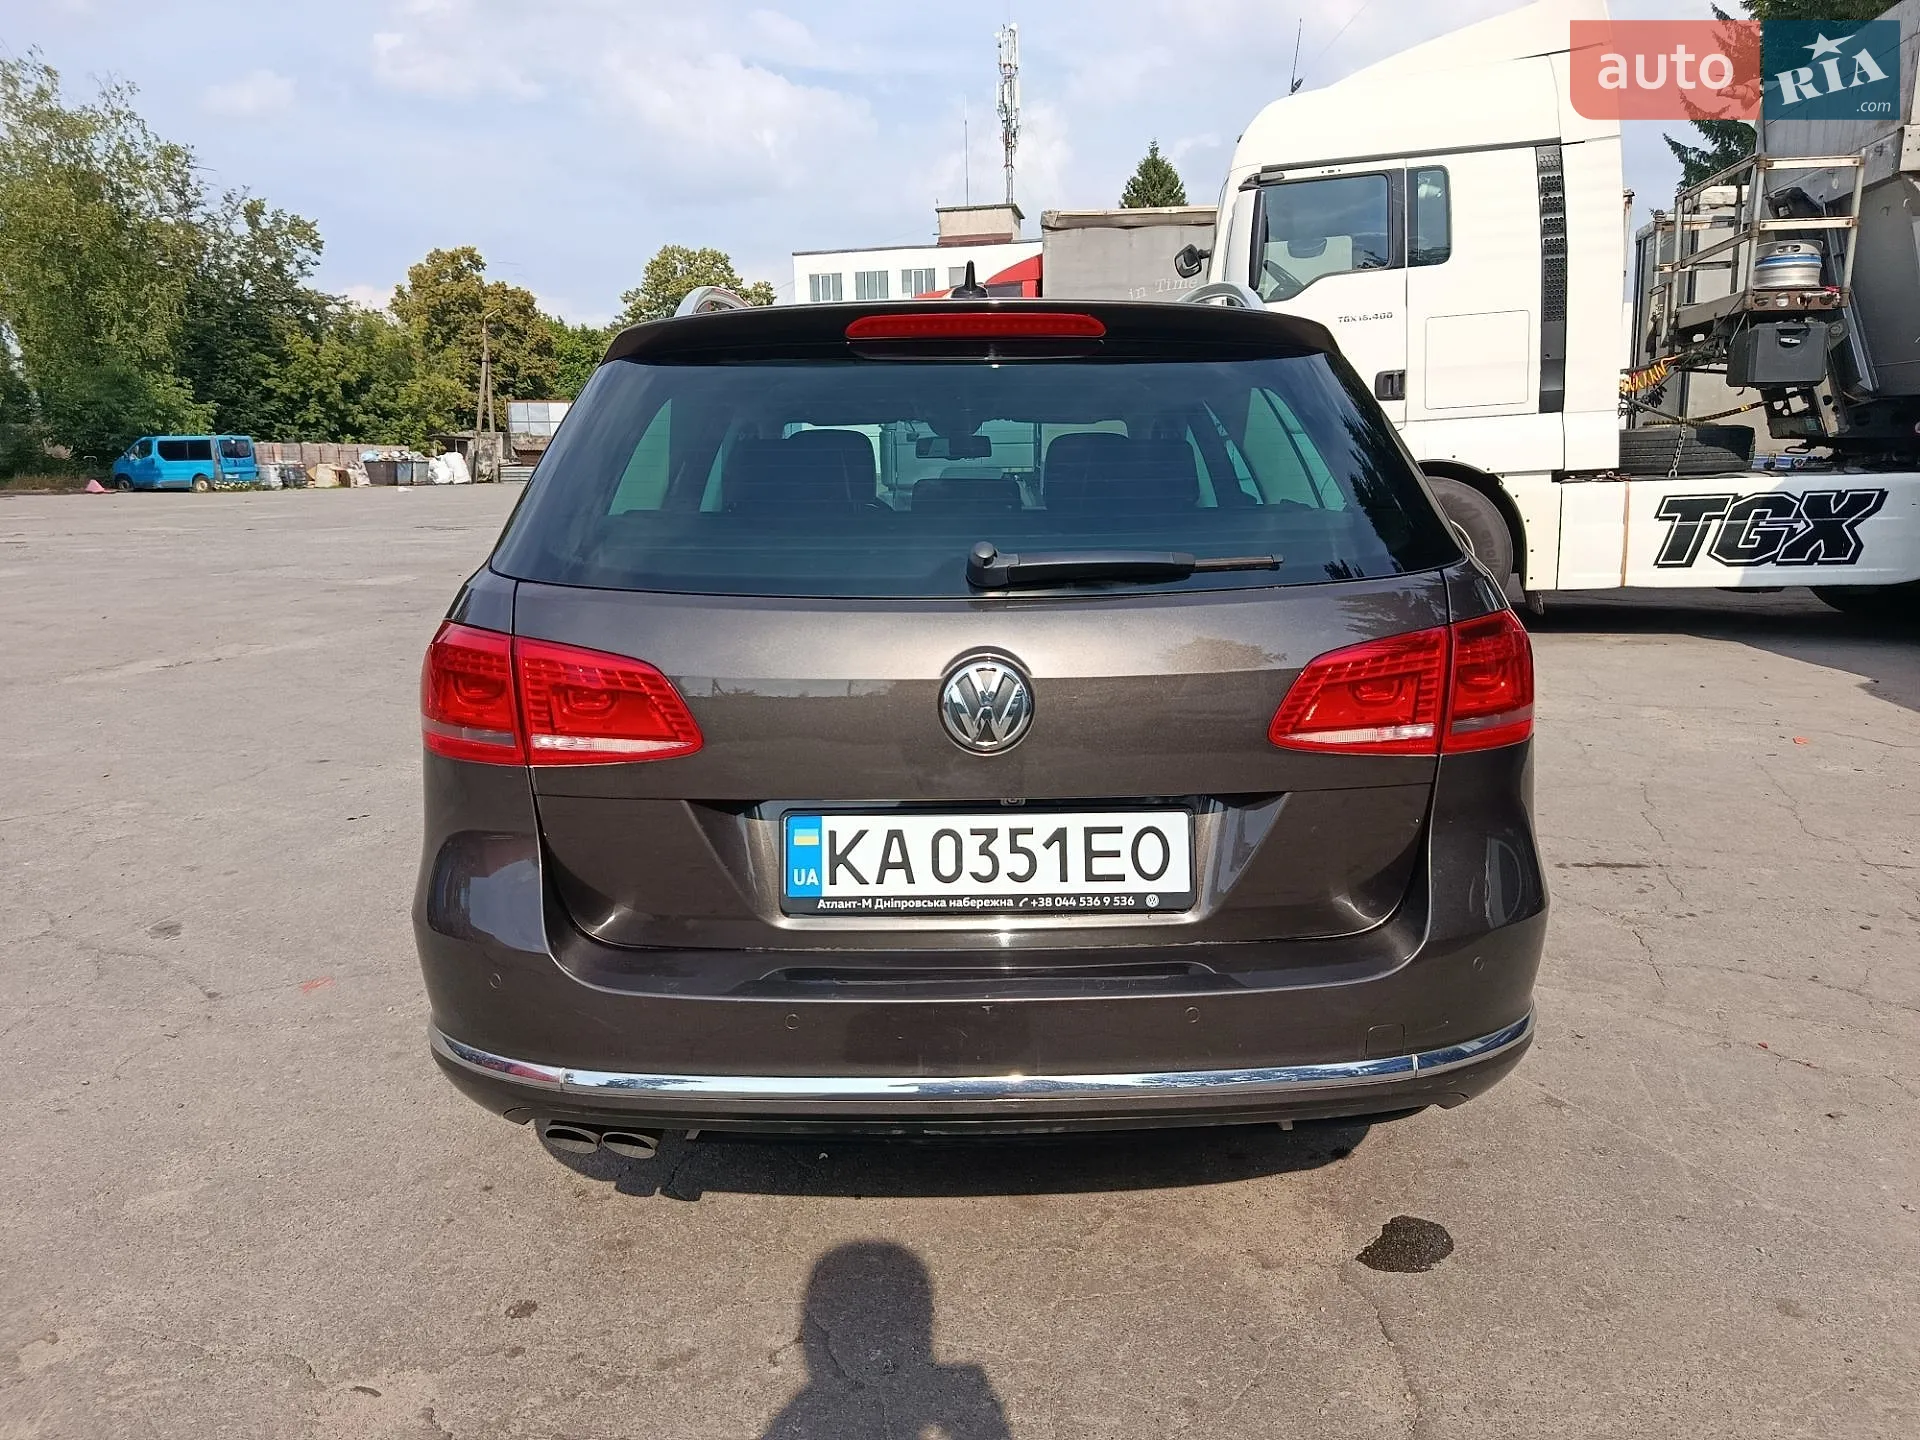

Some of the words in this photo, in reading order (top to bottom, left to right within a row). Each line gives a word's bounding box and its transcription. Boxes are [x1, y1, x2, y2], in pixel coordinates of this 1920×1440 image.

[1653, 488, 1889, 568] TGX
[793, 869, 819, 885] UA
[817, 899, 872, 909] Атлант-М
[874, 898, 947, 909] Дніпровська
[949, 897, 1013, 908] набережна
[1030, 897, 1051, 907] +38
[1055, 897, 1076, 907] 044
[1079, 896, 1100, 906] 536
[1102, 896, 1110, 906] 9
[1113, 896, 1135, 906] 536
